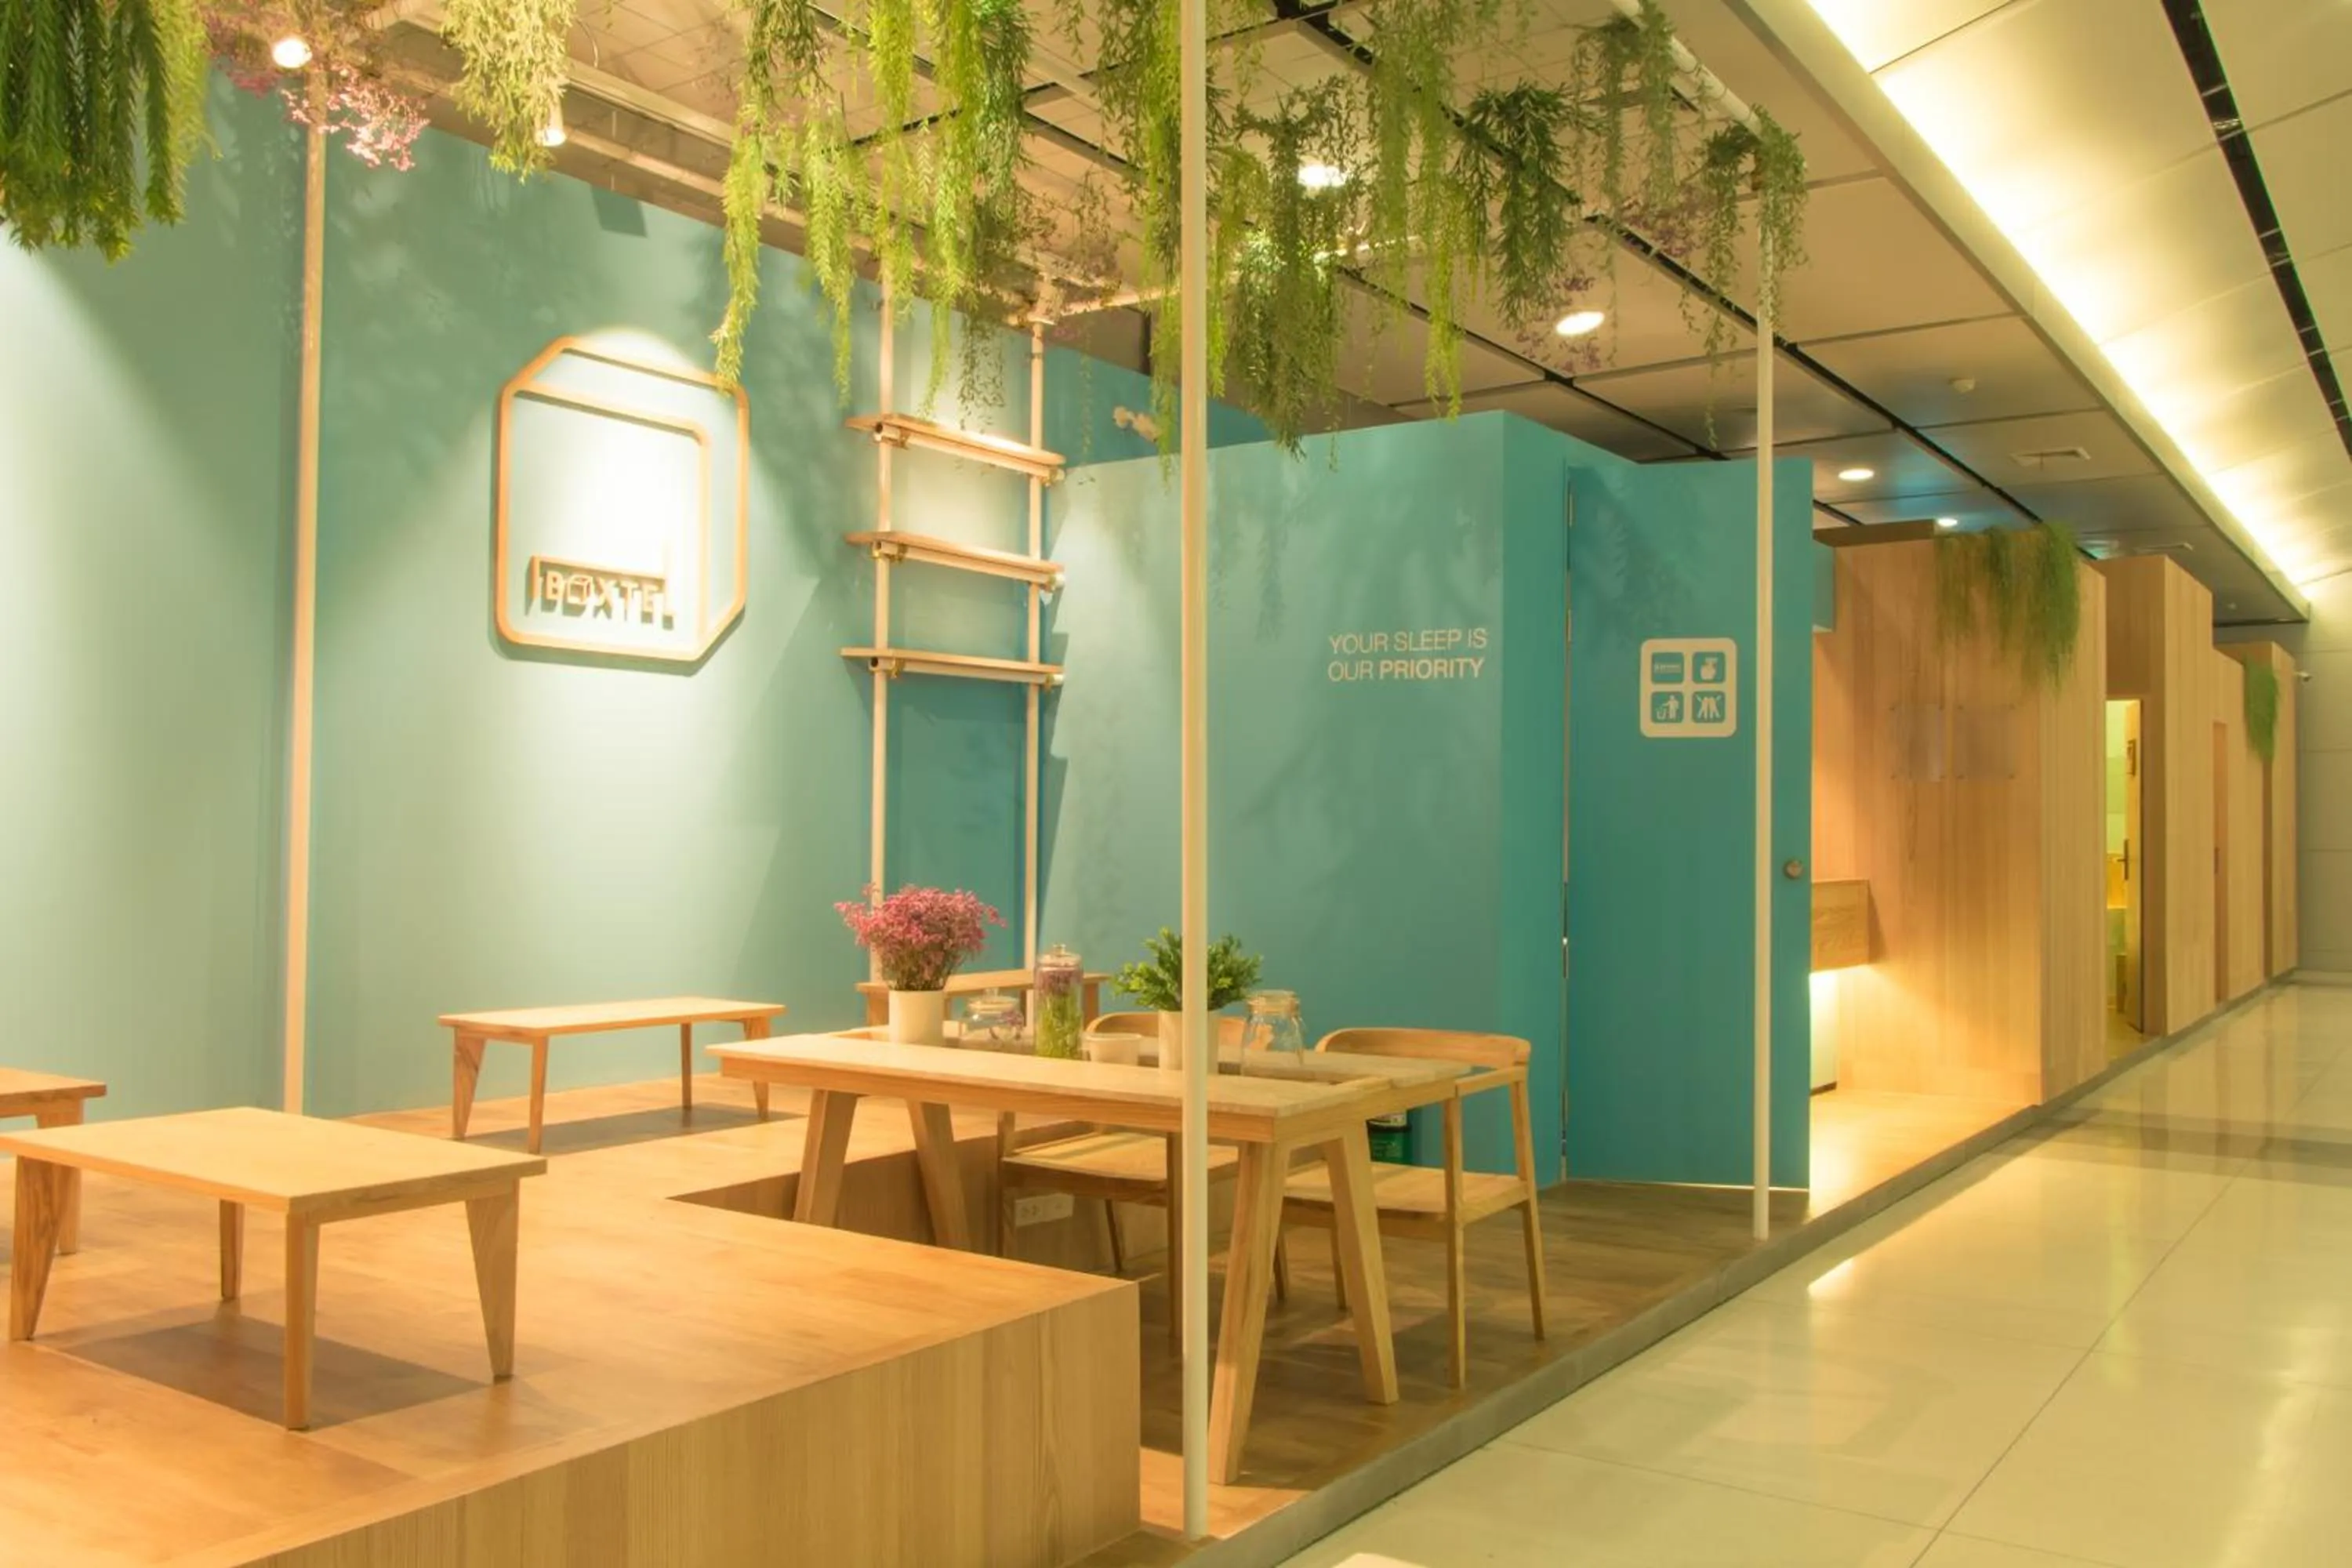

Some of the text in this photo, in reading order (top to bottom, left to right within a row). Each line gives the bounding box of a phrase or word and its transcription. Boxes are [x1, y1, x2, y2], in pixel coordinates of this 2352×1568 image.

[1329, 627, 1488, 654] YOUR SLEEP IS
[1327, 657, 1484, 682] OUR PRIORITY
